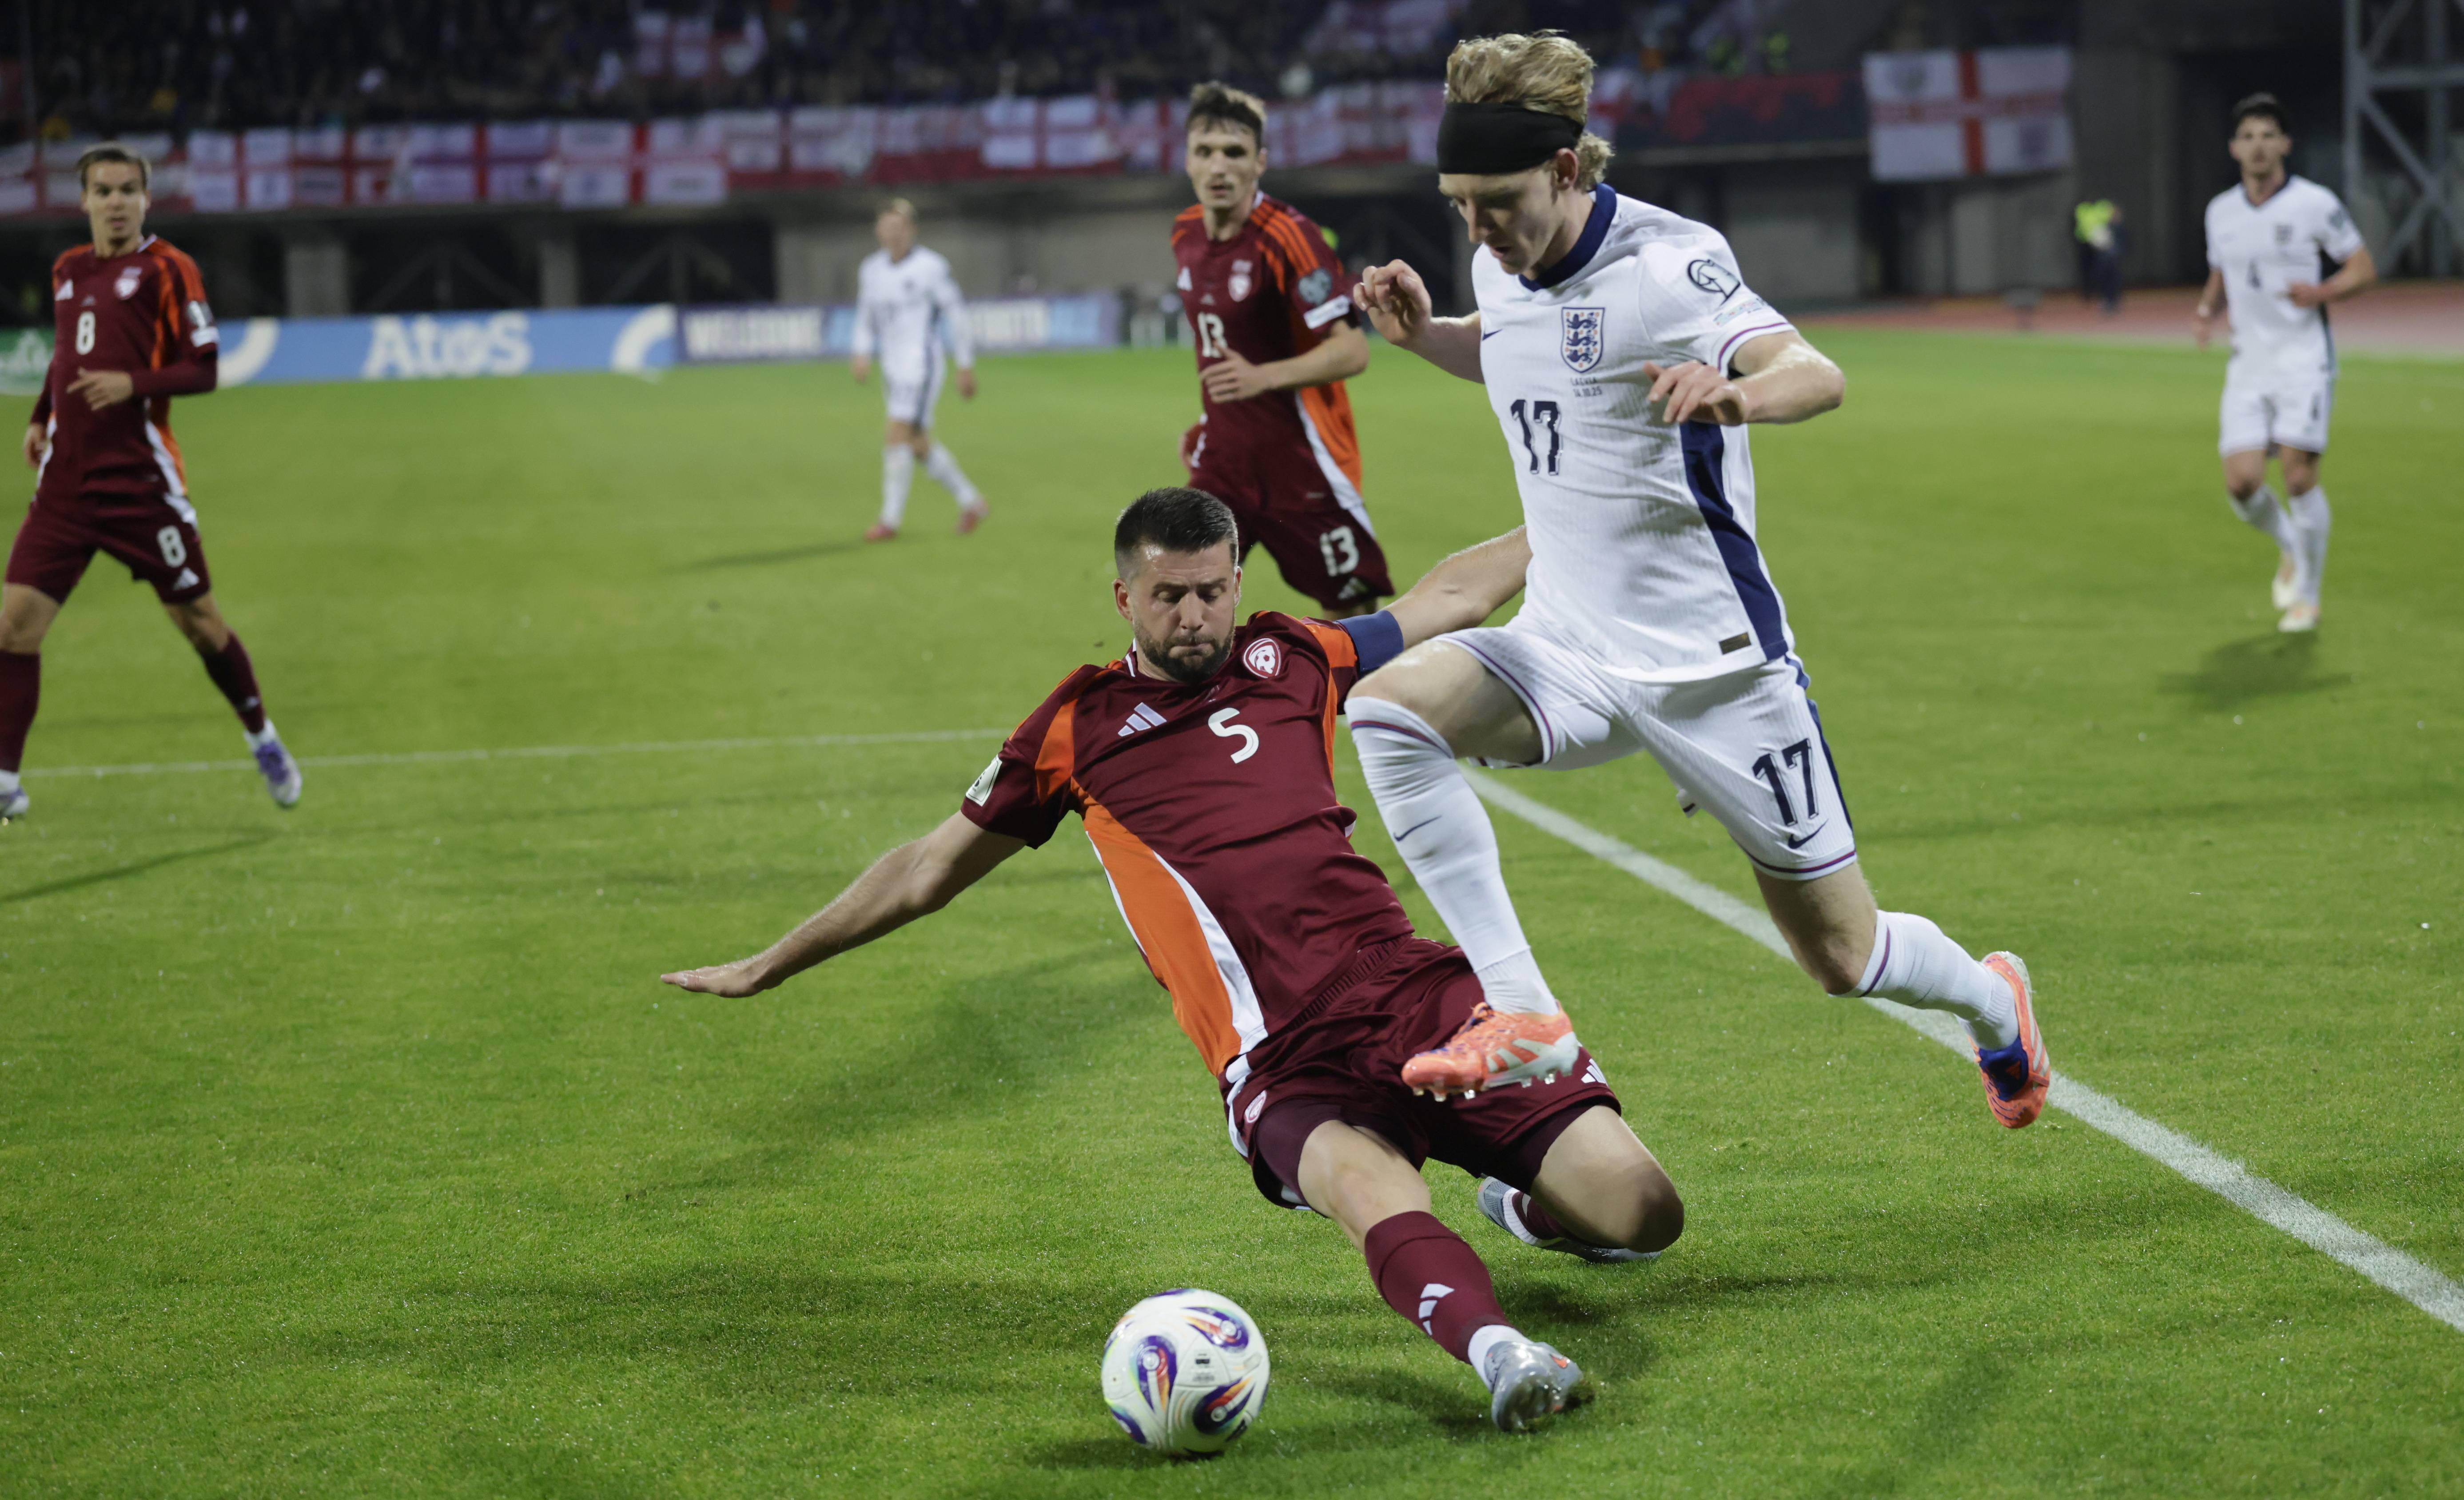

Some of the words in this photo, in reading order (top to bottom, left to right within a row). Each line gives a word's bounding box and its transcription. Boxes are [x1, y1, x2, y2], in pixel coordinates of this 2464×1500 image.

[76, 311, 96, 356] 8
[1510, 399, 1564, 477] 17
[157, 525, 187, 569] 8
[1320, 525, 1360, 577] 13
[1207, 707, 1259, 764] 5
[1751, 738, 1819, 827] 17
